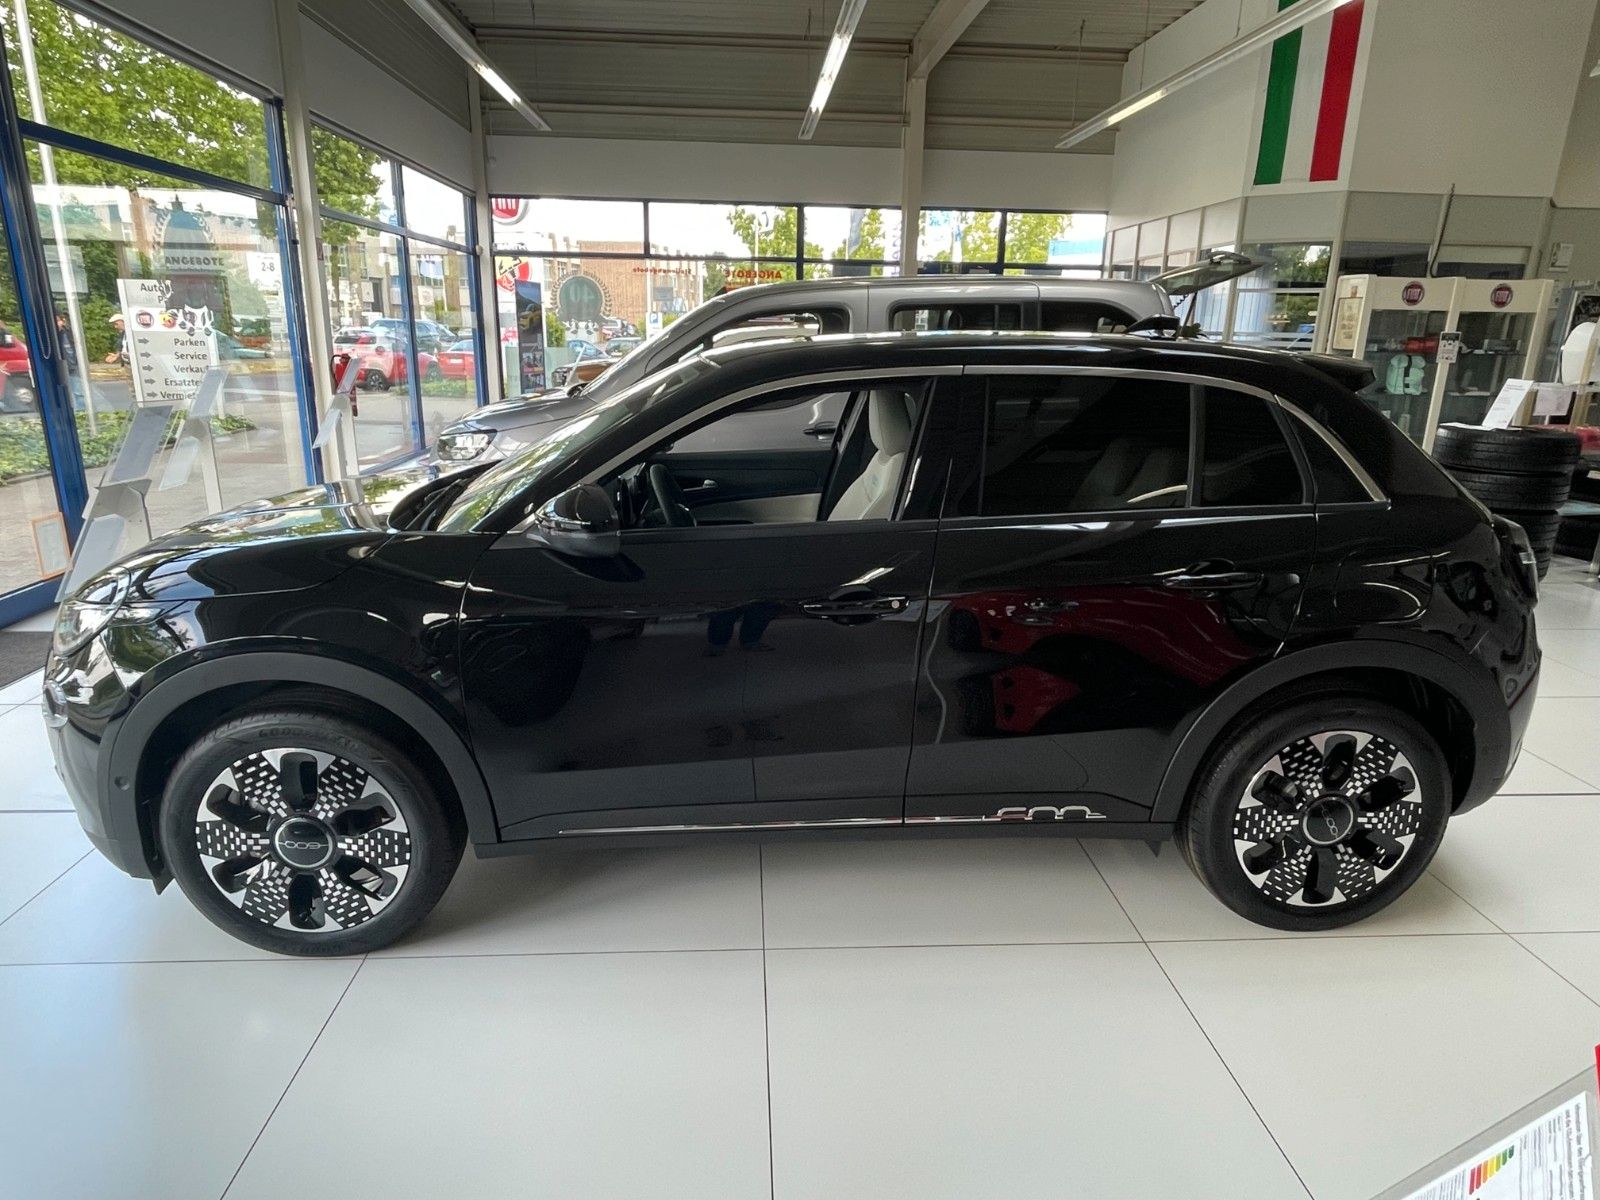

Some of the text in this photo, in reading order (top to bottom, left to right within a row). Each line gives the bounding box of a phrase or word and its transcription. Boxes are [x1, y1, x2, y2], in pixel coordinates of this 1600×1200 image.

[165, 256, 225, 267] ANGEBOTE
[141, 283, 165, 292] Auto
[174, 338, 206, 347] Parken
[174, 352, 208, 360] Service
[164, 378, 201, 387] Ersatzte
[160, 391, 196, 400] Vermiet
